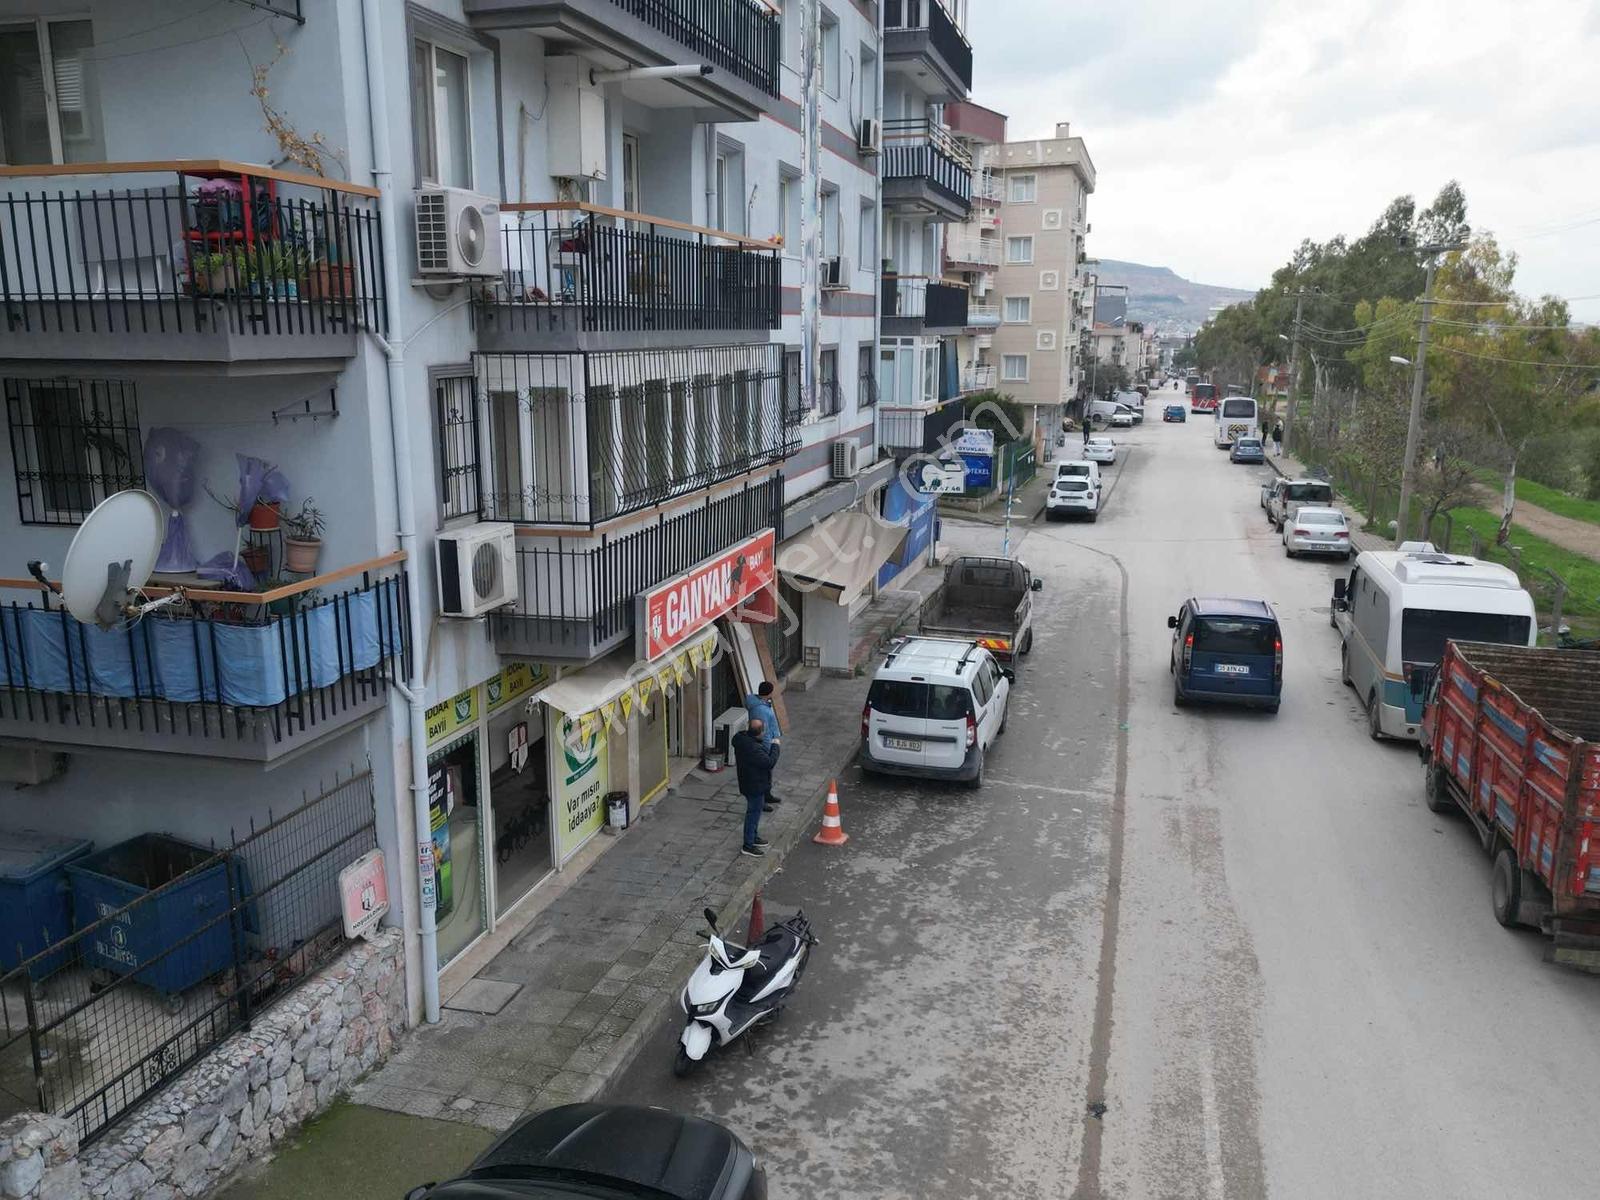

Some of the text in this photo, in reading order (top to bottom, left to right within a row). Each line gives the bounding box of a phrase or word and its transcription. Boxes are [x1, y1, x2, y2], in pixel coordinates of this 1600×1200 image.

[666, 561, 732, 637] GANYAN
[567, 796, 580, 814] Var
[568, 795, 601, 833] iddaaya?
